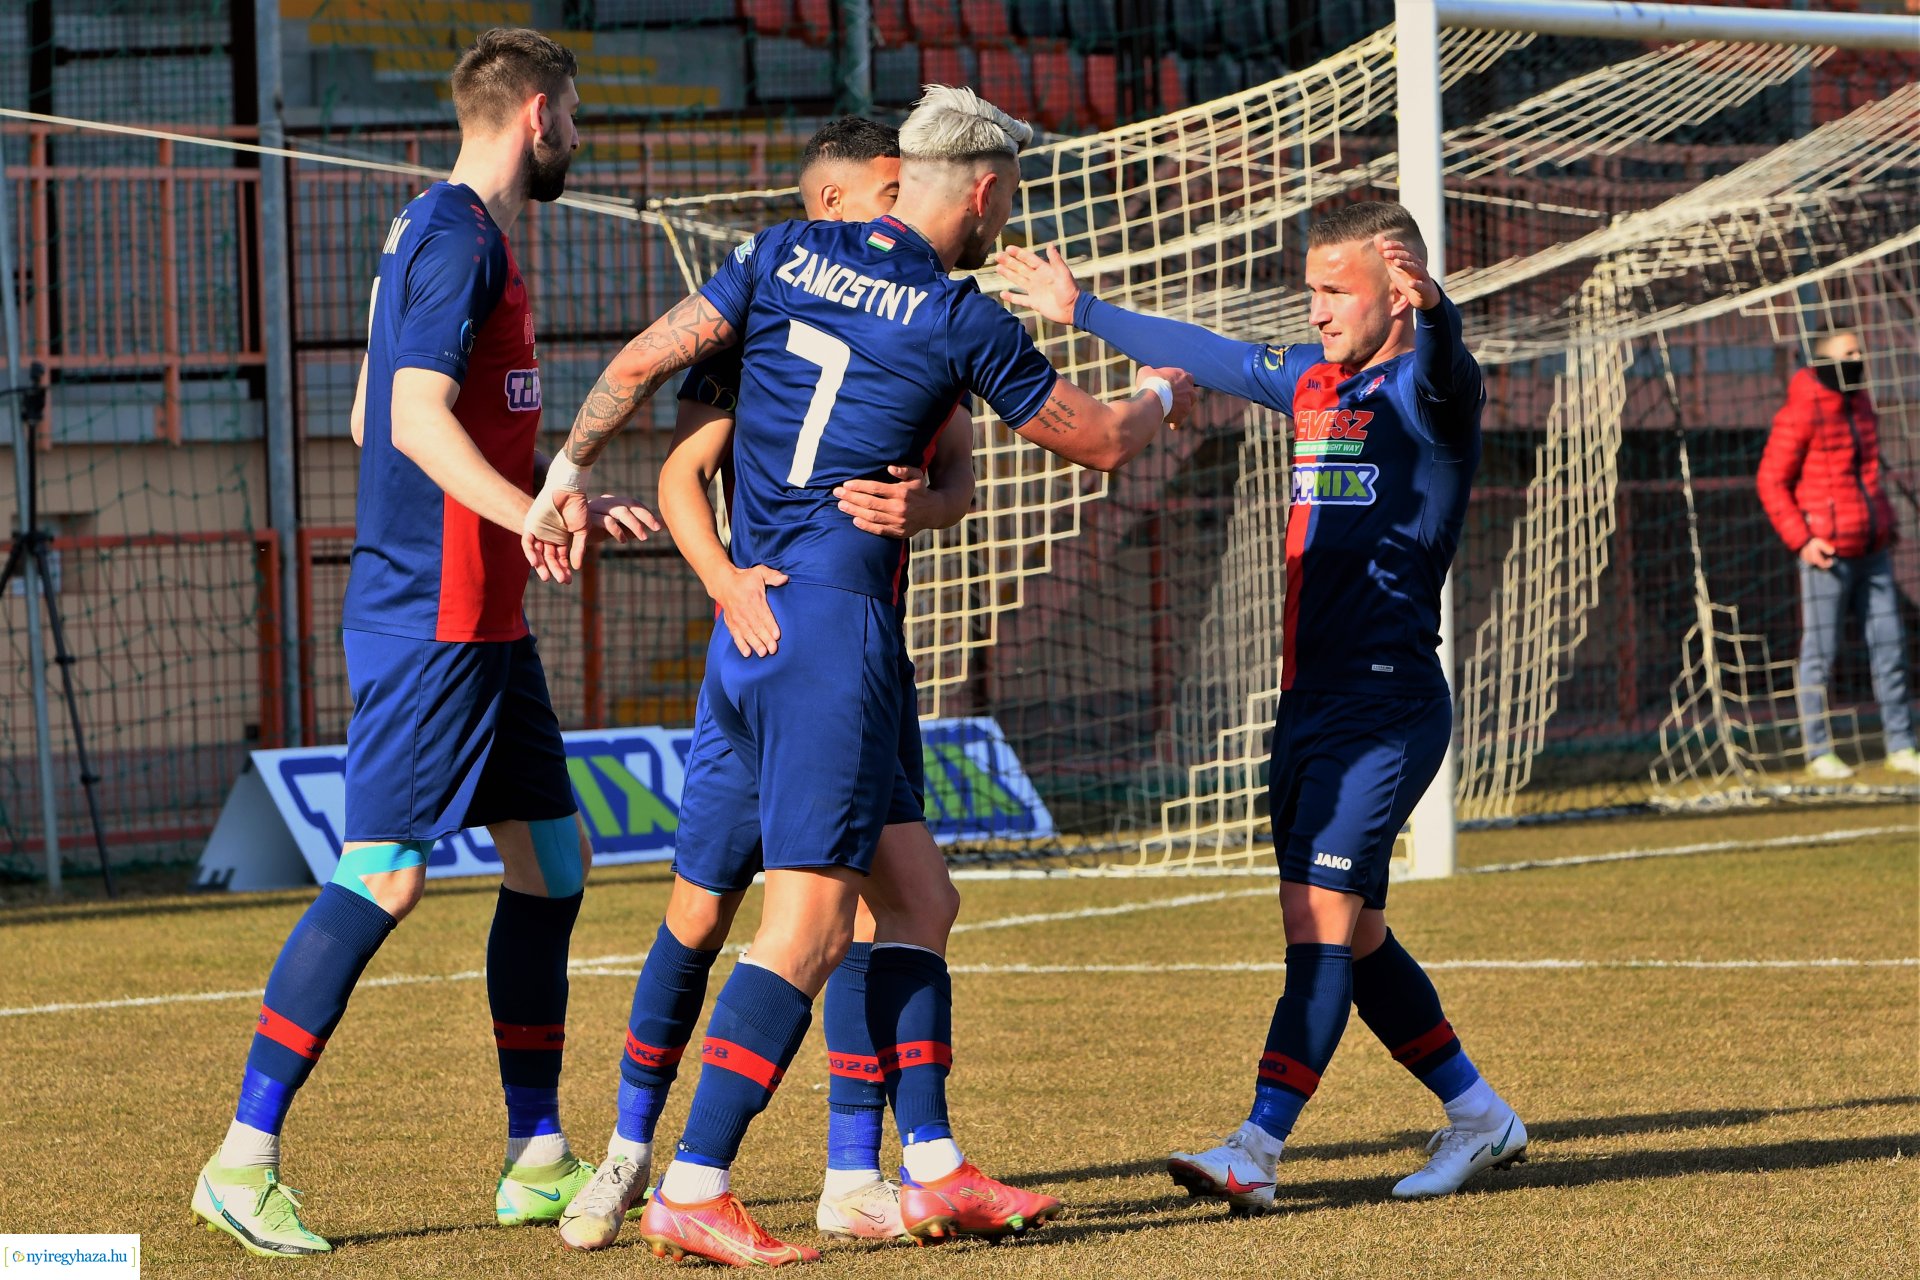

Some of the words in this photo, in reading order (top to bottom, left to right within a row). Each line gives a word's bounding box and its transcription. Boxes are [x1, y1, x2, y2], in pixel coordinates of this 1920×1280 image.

[777, 245, 928, 325] ZAMOSTNY
[786, 319, 850, 488] 7
[1294, 410, 1374, 440] EVESZ
[1343, 444, 1360, 452] WAY
[1314, 852, 1352, 871] JAKO
